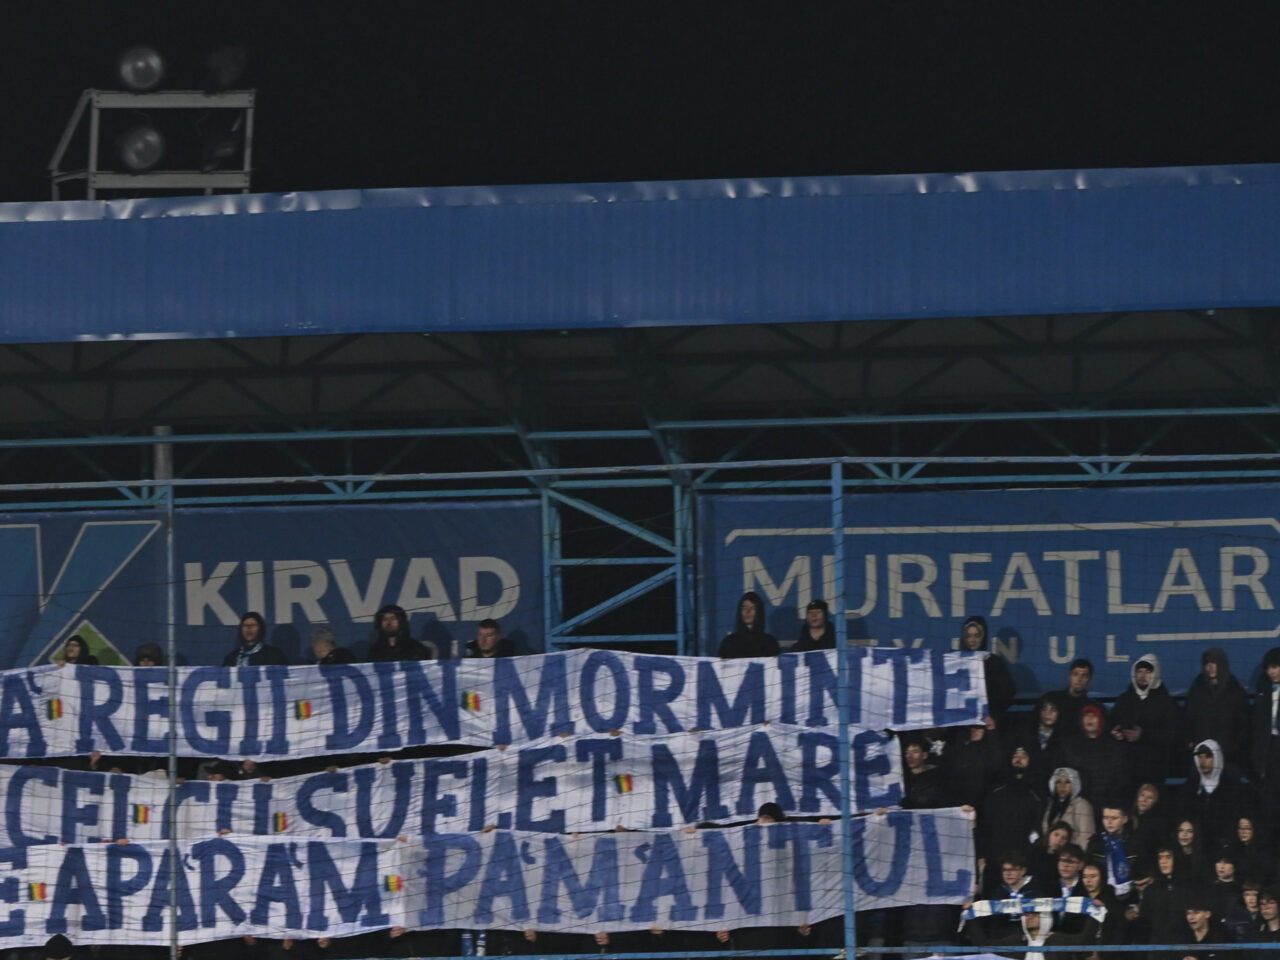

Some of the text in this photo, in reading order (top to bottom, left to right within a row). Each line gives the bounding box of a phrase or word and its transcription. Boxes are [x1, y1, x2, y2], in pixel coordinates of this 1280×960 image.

[184, 557, 521, 626] KIRVAD
[742, 546, 1275, 620] MURFATLAR
[75, 664, 289, 756] REGII
[319, 659, 463, 750] DIN
[493, 648, 986, 747] MORMINTE
[651, 730, 905, 828] MARE
